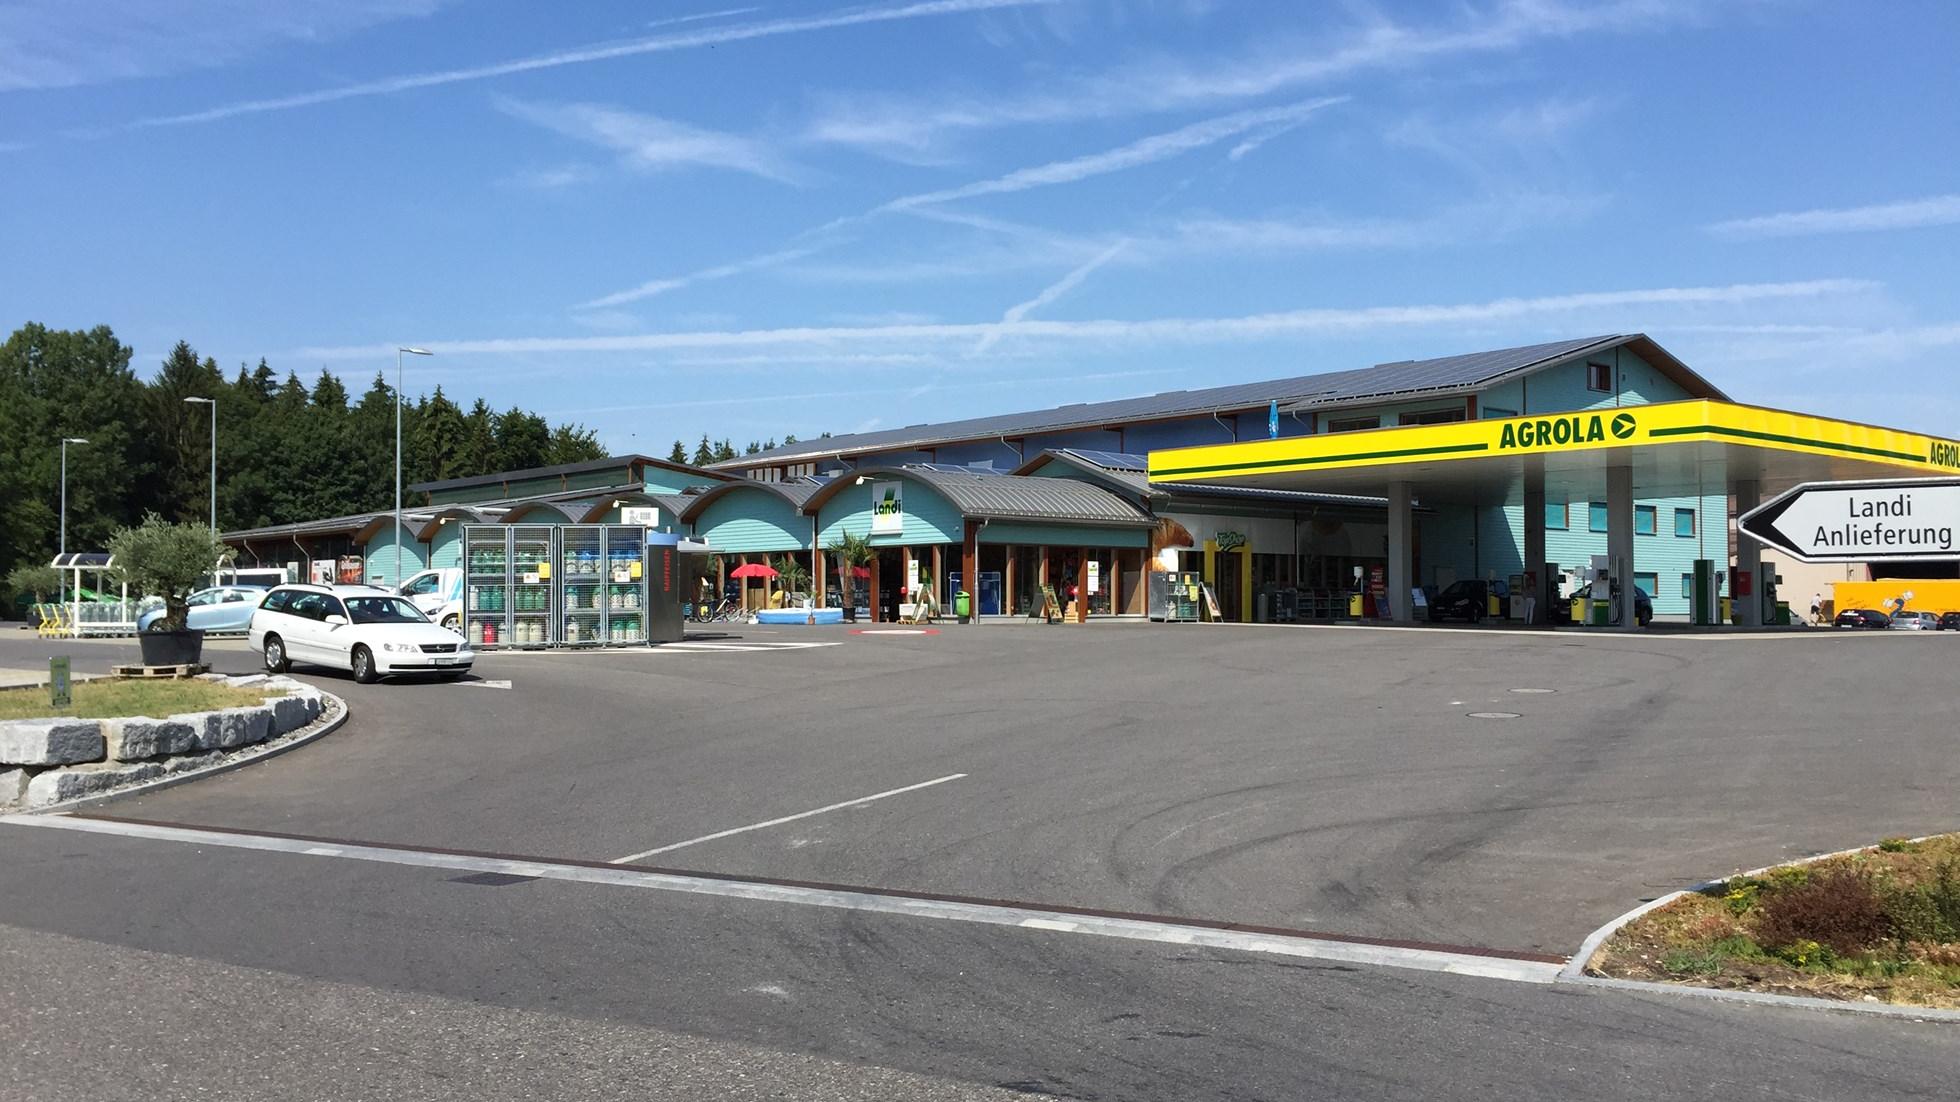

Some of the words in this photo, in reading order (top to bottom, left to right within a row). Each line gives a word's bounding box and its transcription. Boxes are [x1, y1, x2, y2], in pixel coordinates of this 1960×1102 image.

[1500, 416, 1605, 448] AGROLA
[873, 499, 902, 515] Landi
[1849, 494, 1912, 518] Landi
[1813, 522, 1952, 549] Anlieferung
